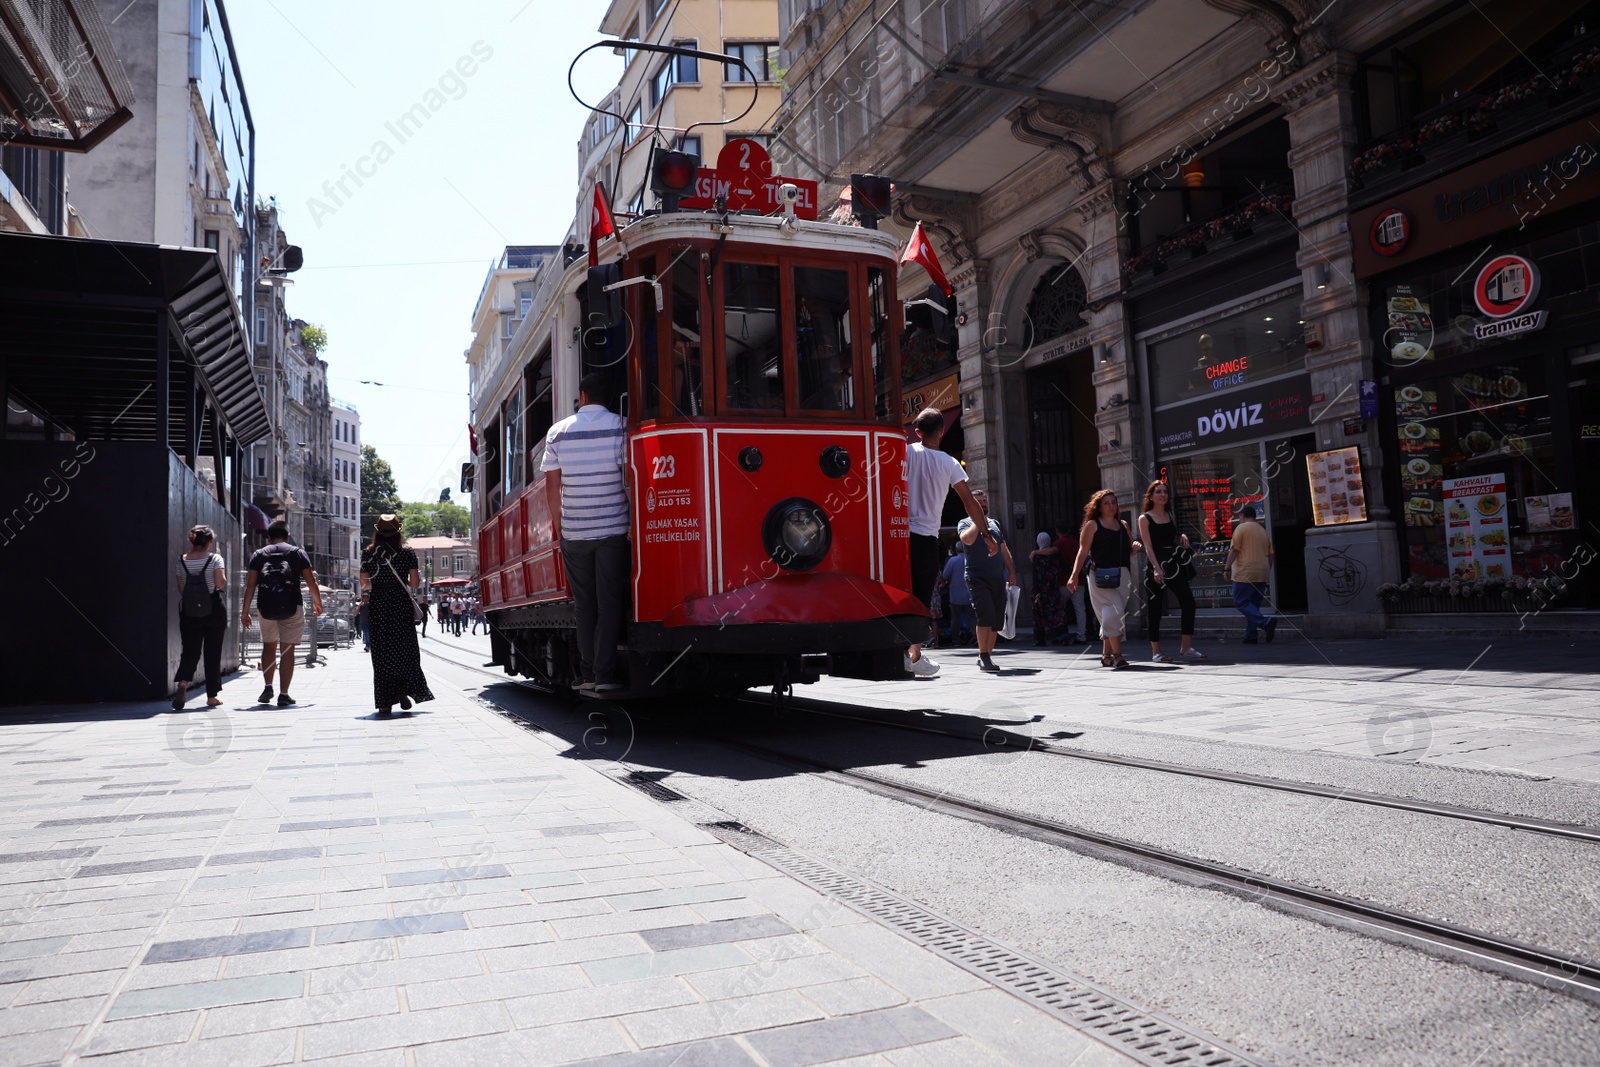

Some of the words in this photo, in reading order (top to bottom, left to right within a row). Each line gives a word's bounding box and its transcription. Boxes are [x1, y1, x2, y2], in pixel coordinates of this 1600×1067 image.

[739, 143, 751, 168] 2
[695, 173, 730, 200] KSİM
[765, 179, 813, 209] TÜEL
[1475, 313, 1540, 338] tramvay
[1205, 356, 1248, 380] CHANGE
[1213, 372, 1244, 390] OFFICE
[1159, 431, 1193, 445] BAYRAKTAR
[1197, 401, 1264, 437] DÖVİZ
[652, 455, 675, 480] 223
[1452, 485, 1495, 498] BREAKFAST
[1453, 476, 1492, 487] KAHVALTI
[658, 498, 674, 507] ALO
[675, 497, 691, 506] 153
[646, 519, 673, 530] ASILMAK
[673, 517, 699, 528] YASAK
[645, 533, 652, 543] VE
[652, 530, 701, 543] TEHLİKELİDİR
